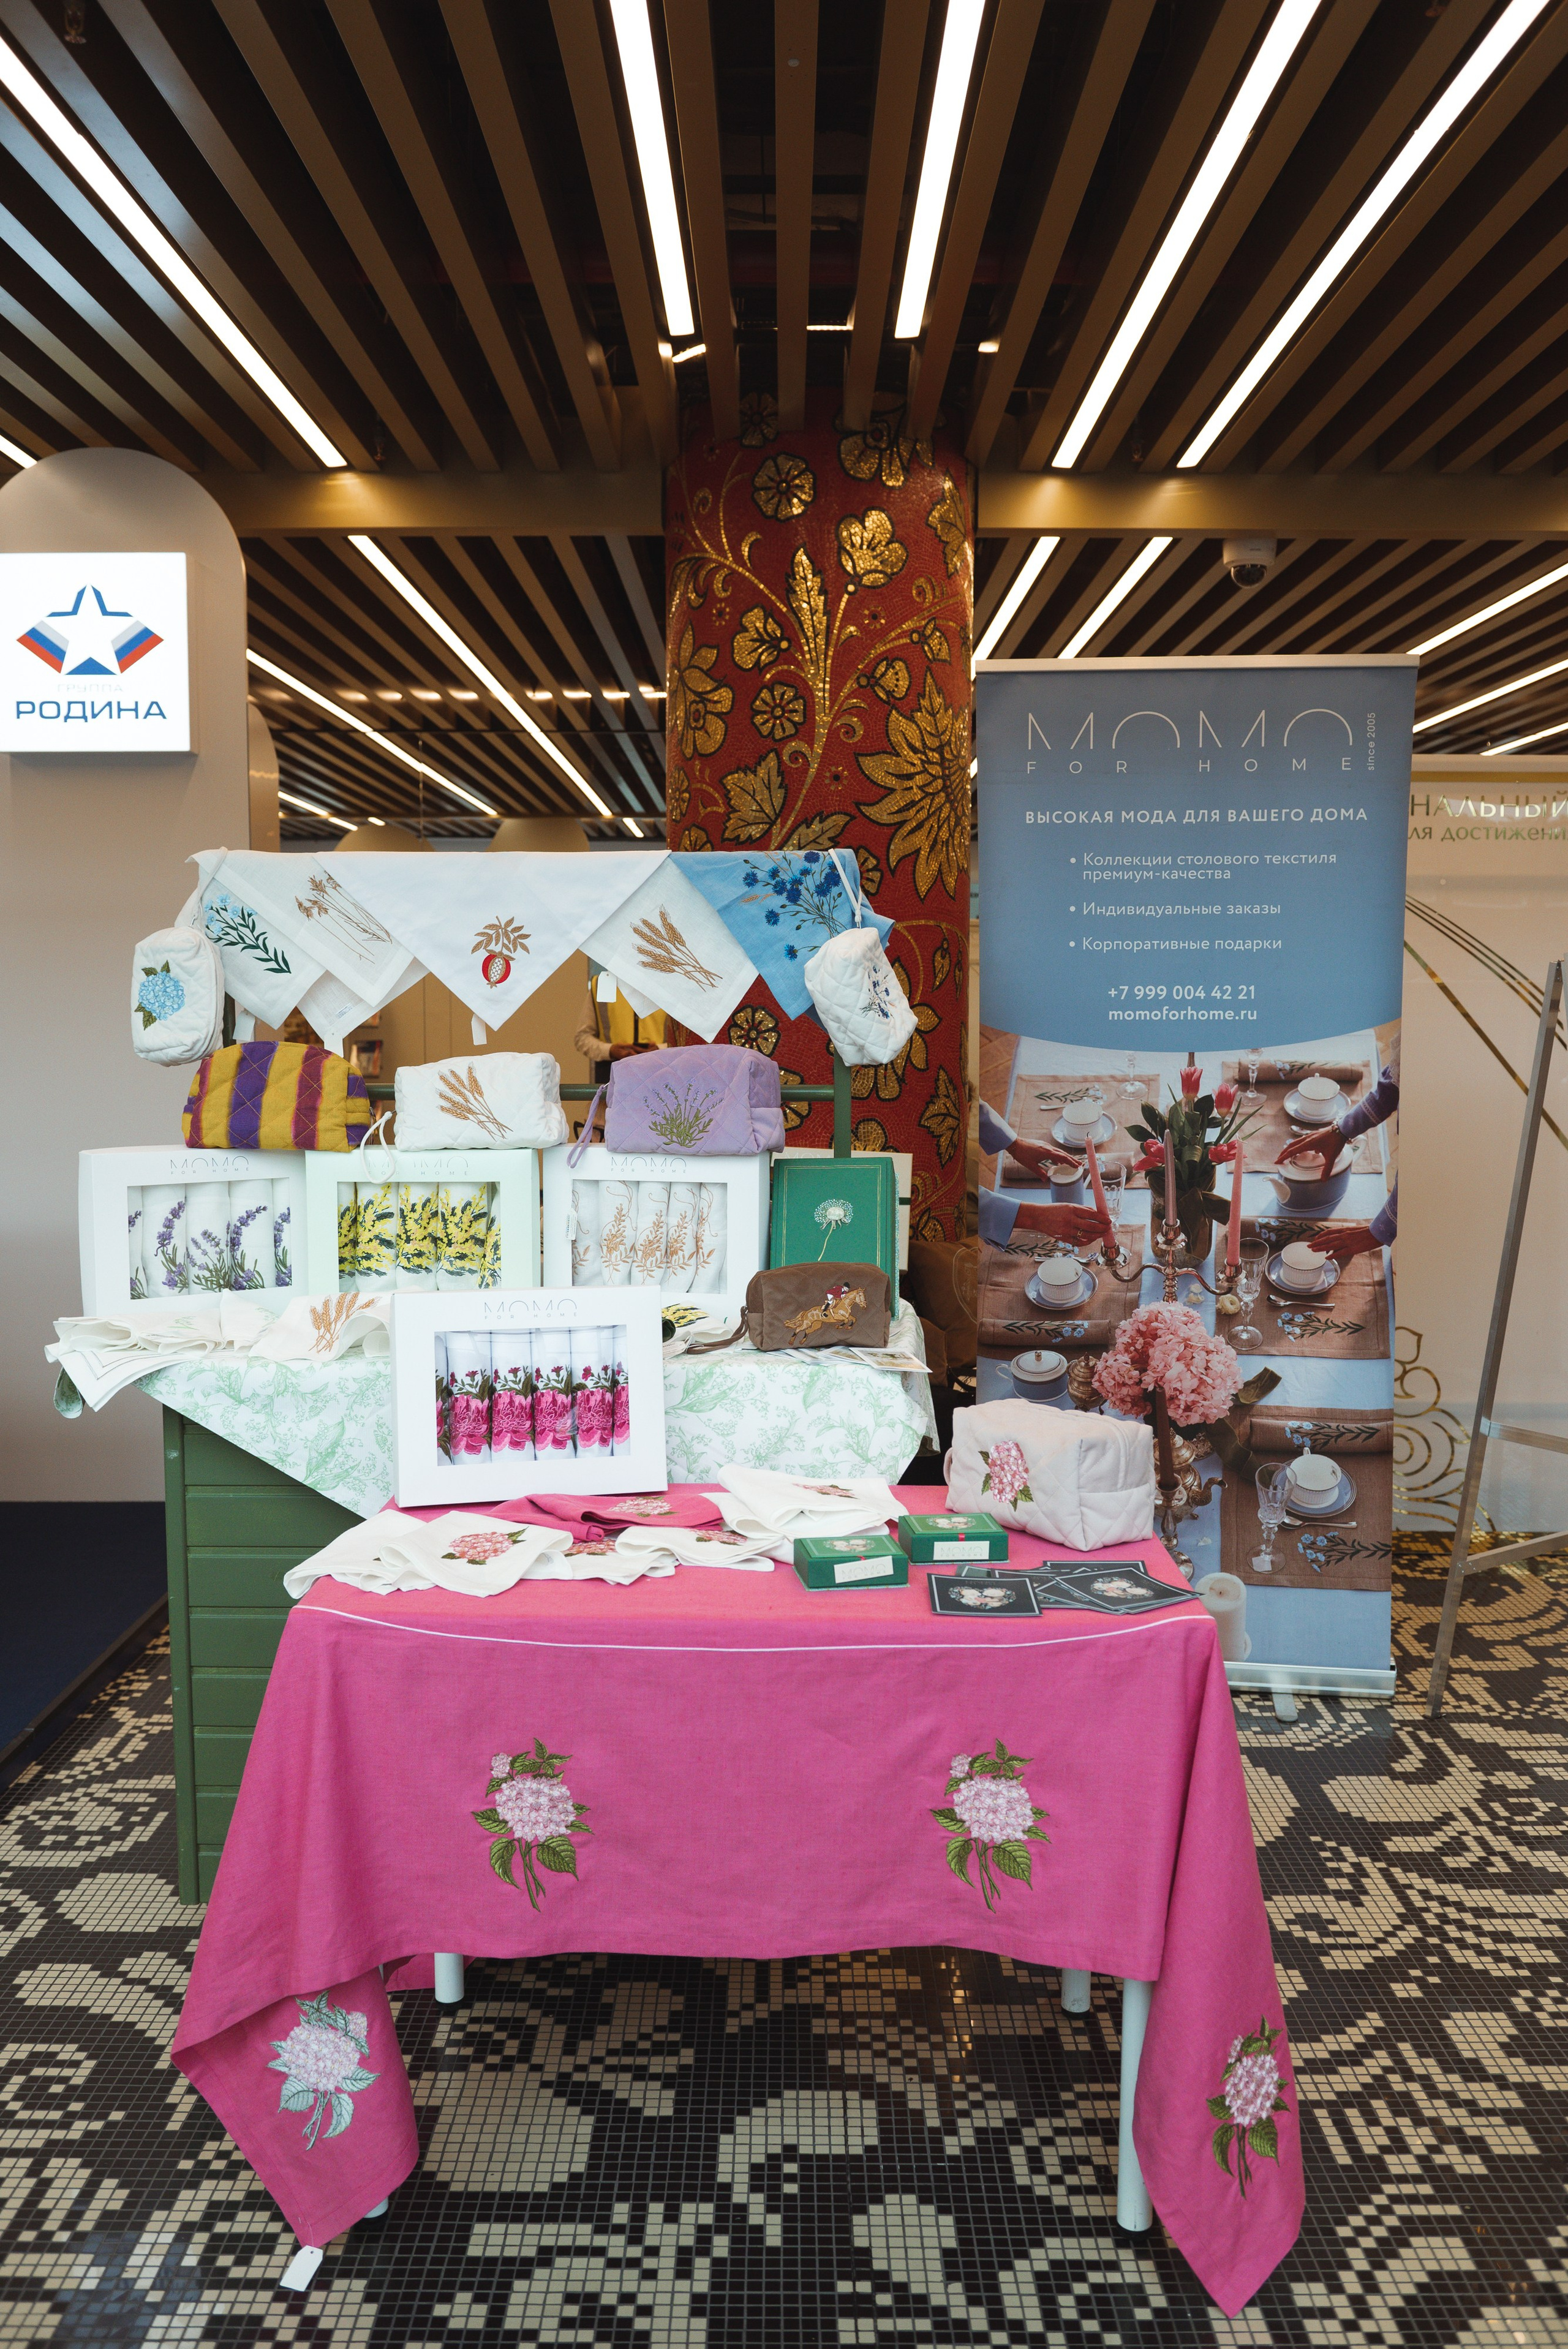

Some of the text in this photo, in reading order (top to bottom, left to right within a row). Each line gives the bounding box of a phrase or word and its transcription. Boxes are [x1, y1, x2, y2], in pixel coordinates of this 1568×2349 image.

[16, 701, 168, 723] РОДИНА
[1028, 708, 1352, 750] MOMO
[1366, 712, 1376, 771] since 2005
[1027, 757, 1352, 774] FOR HOME
[1411, 790, 1568, 818] НАЛЬНЫЙ
[1025, 807, 1368, 824] ВЫСОКАЯ МОДА ДЛЯ ВАШЕГО ДОМА
[1441, 826, 1568, 842] достижени
[1083, 852, 1337, 867] Коллекции столового текстиля
[1082, 869, 1231, 883] премиум-качества
[1082, 902, 1281, 918] Индивидуальные заказы
[1082, 937, 1282, 953] Корпоративные подарки
[1108, 984, 1255, 1000] +7 999 004 42 21
[1108, 1006, 1257, 1020] momoforhome.ru
[170, 1155, 249, 1169] MOMO
[611, 1156, 687, 1167] MOMO
[484, 1299, 578, 1313] MOMO
